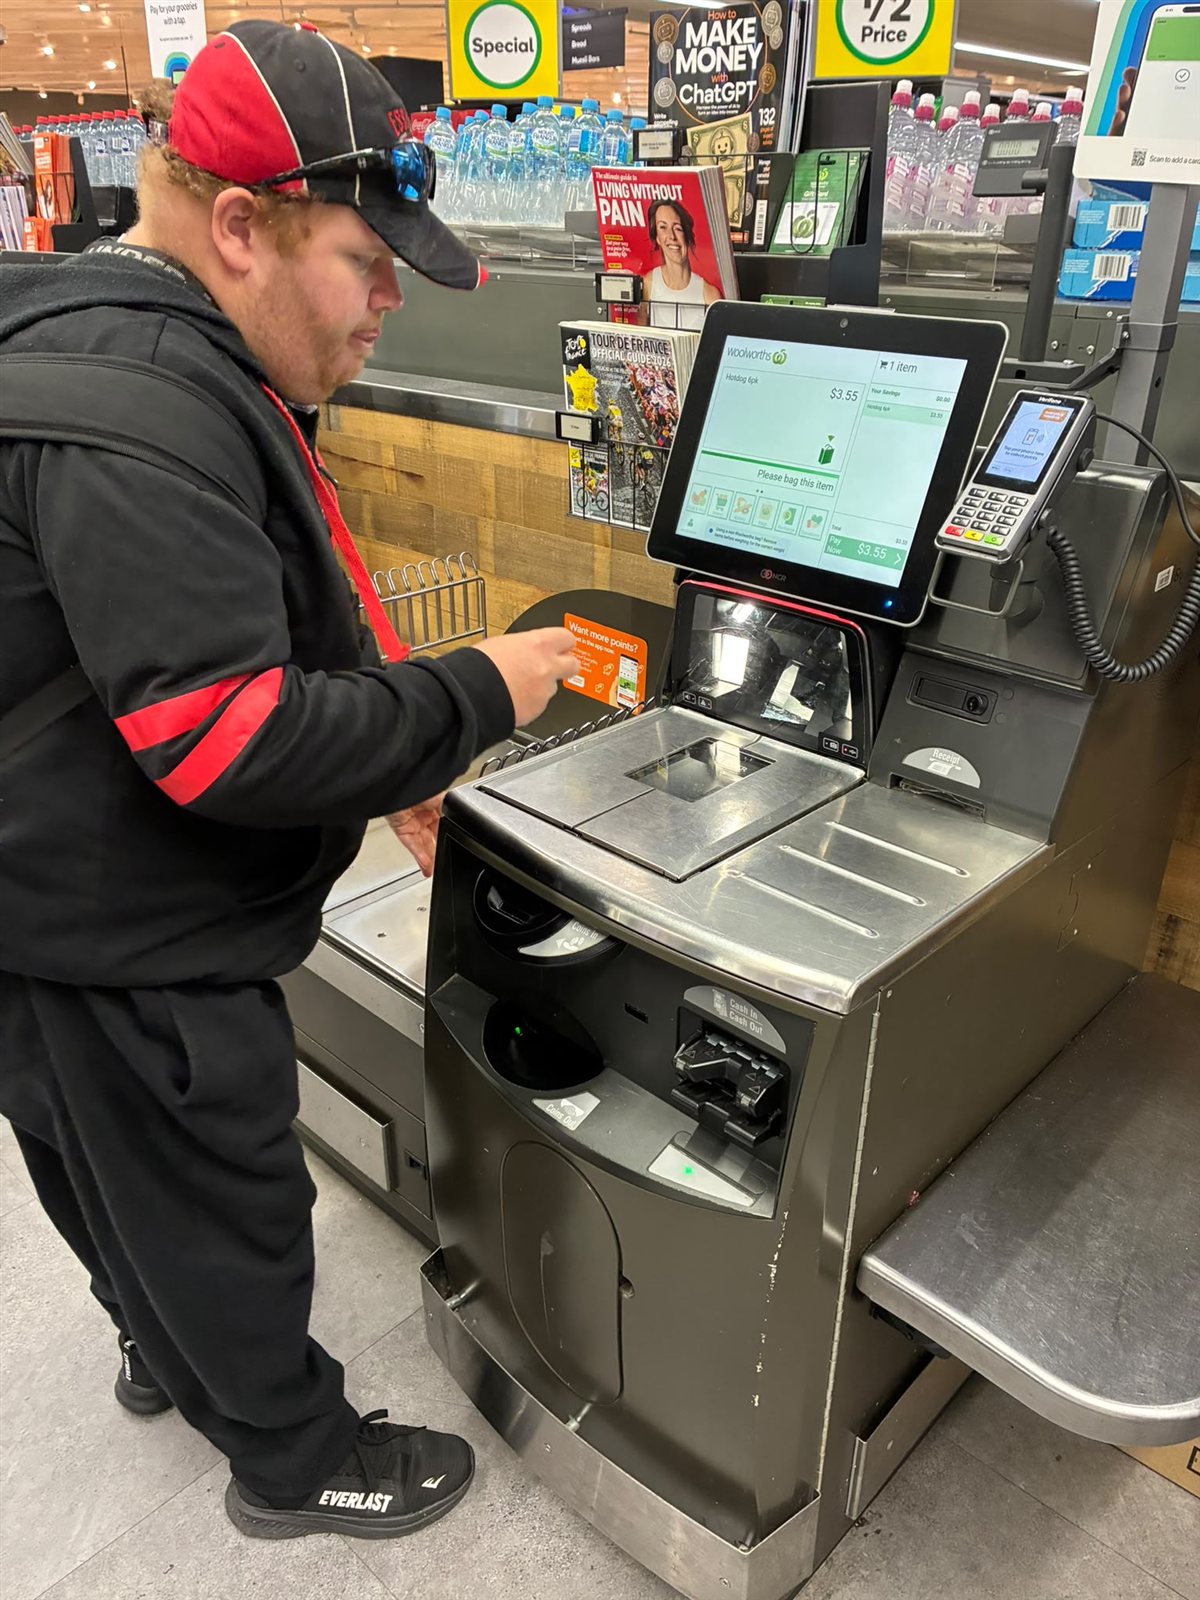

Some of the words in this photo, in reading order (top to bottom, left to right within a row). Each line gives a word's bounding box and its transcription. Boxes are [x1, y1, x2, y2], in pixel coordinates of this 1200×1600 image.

[166, 6, 175, 14] your
[176, 3, 197, 13] groceries
[708, 10, 727, 20] How
[728, 10, 736, 19] to
[571, 22, 592, 34] Spreads
[685, 17, 756, 48] MAKE
[861, 25, 907, 43] Price
[472, 37, 534, 58] Special
[571, 40, 587, 49] Bread
[675, 42, 763, 74] MONEY
[711, 72, 728, 83] with
[680, 80, 757, 104] ChatGPT
[758, 107, 776, 126] 132
[1149, 155, 1164, 163] Scan
[603, 173, 619, 181] ultimate
[620, 174, 632, 183] guide
[597, 181, 629, 199] LIVING
[630, 183, 682, 201] WITHOUT
[599, 198, 646, 227] PAIN
[591, 333, 617, 349] TOUR
[617, 337, 632, 350] DE
[632, 339, 669, 356] FRANCE
[592, 349, 625, 361] OFFICIAL
[627, 352, 651, 364] GUIDE
[651, 355, 671, 367] 2026
[727, 346, 772, 361] woolworths
[889, 361, 895, 371] 1
[896, 361, 918, 374] item
[726, 373, 747, 384] Hotdog
[748, 376, 759, 384] 6pk
[830, 387, 859, 402] $3.55
[883, 389, 901, 397] Savings
[757, 469, 783, 482] Please
[783, 473, 799, 487] bag
[800, 476, 815, 488] this
[816, 480, 834, 492] item
[830, 535, 841, 546] Pay
[826, 545, 842, 554] Now
[857, 543, 887, 559] $3.55
[772, 573, 787, 582] NCR
[569, 620, 589, 636] Want
[590, 630, 609, 643] more
[610, 638, 638, 653] points?
[933, 748, 960, 765] Receipt
[572, 921, 590, 936] Coins
[590, 930, 599, 940] In
[730, 998, 748, 1015] Cash
[750, 1009, 758, 1020] In
[730, 1011, 748, 1027] Cash
[750, 1021, 763, 1035] Out
[546, 1104, 564, 1120] Coins
[563, 1115, 577, 1130] Out
[318, 1490, 393, 1513] EVERLAST
